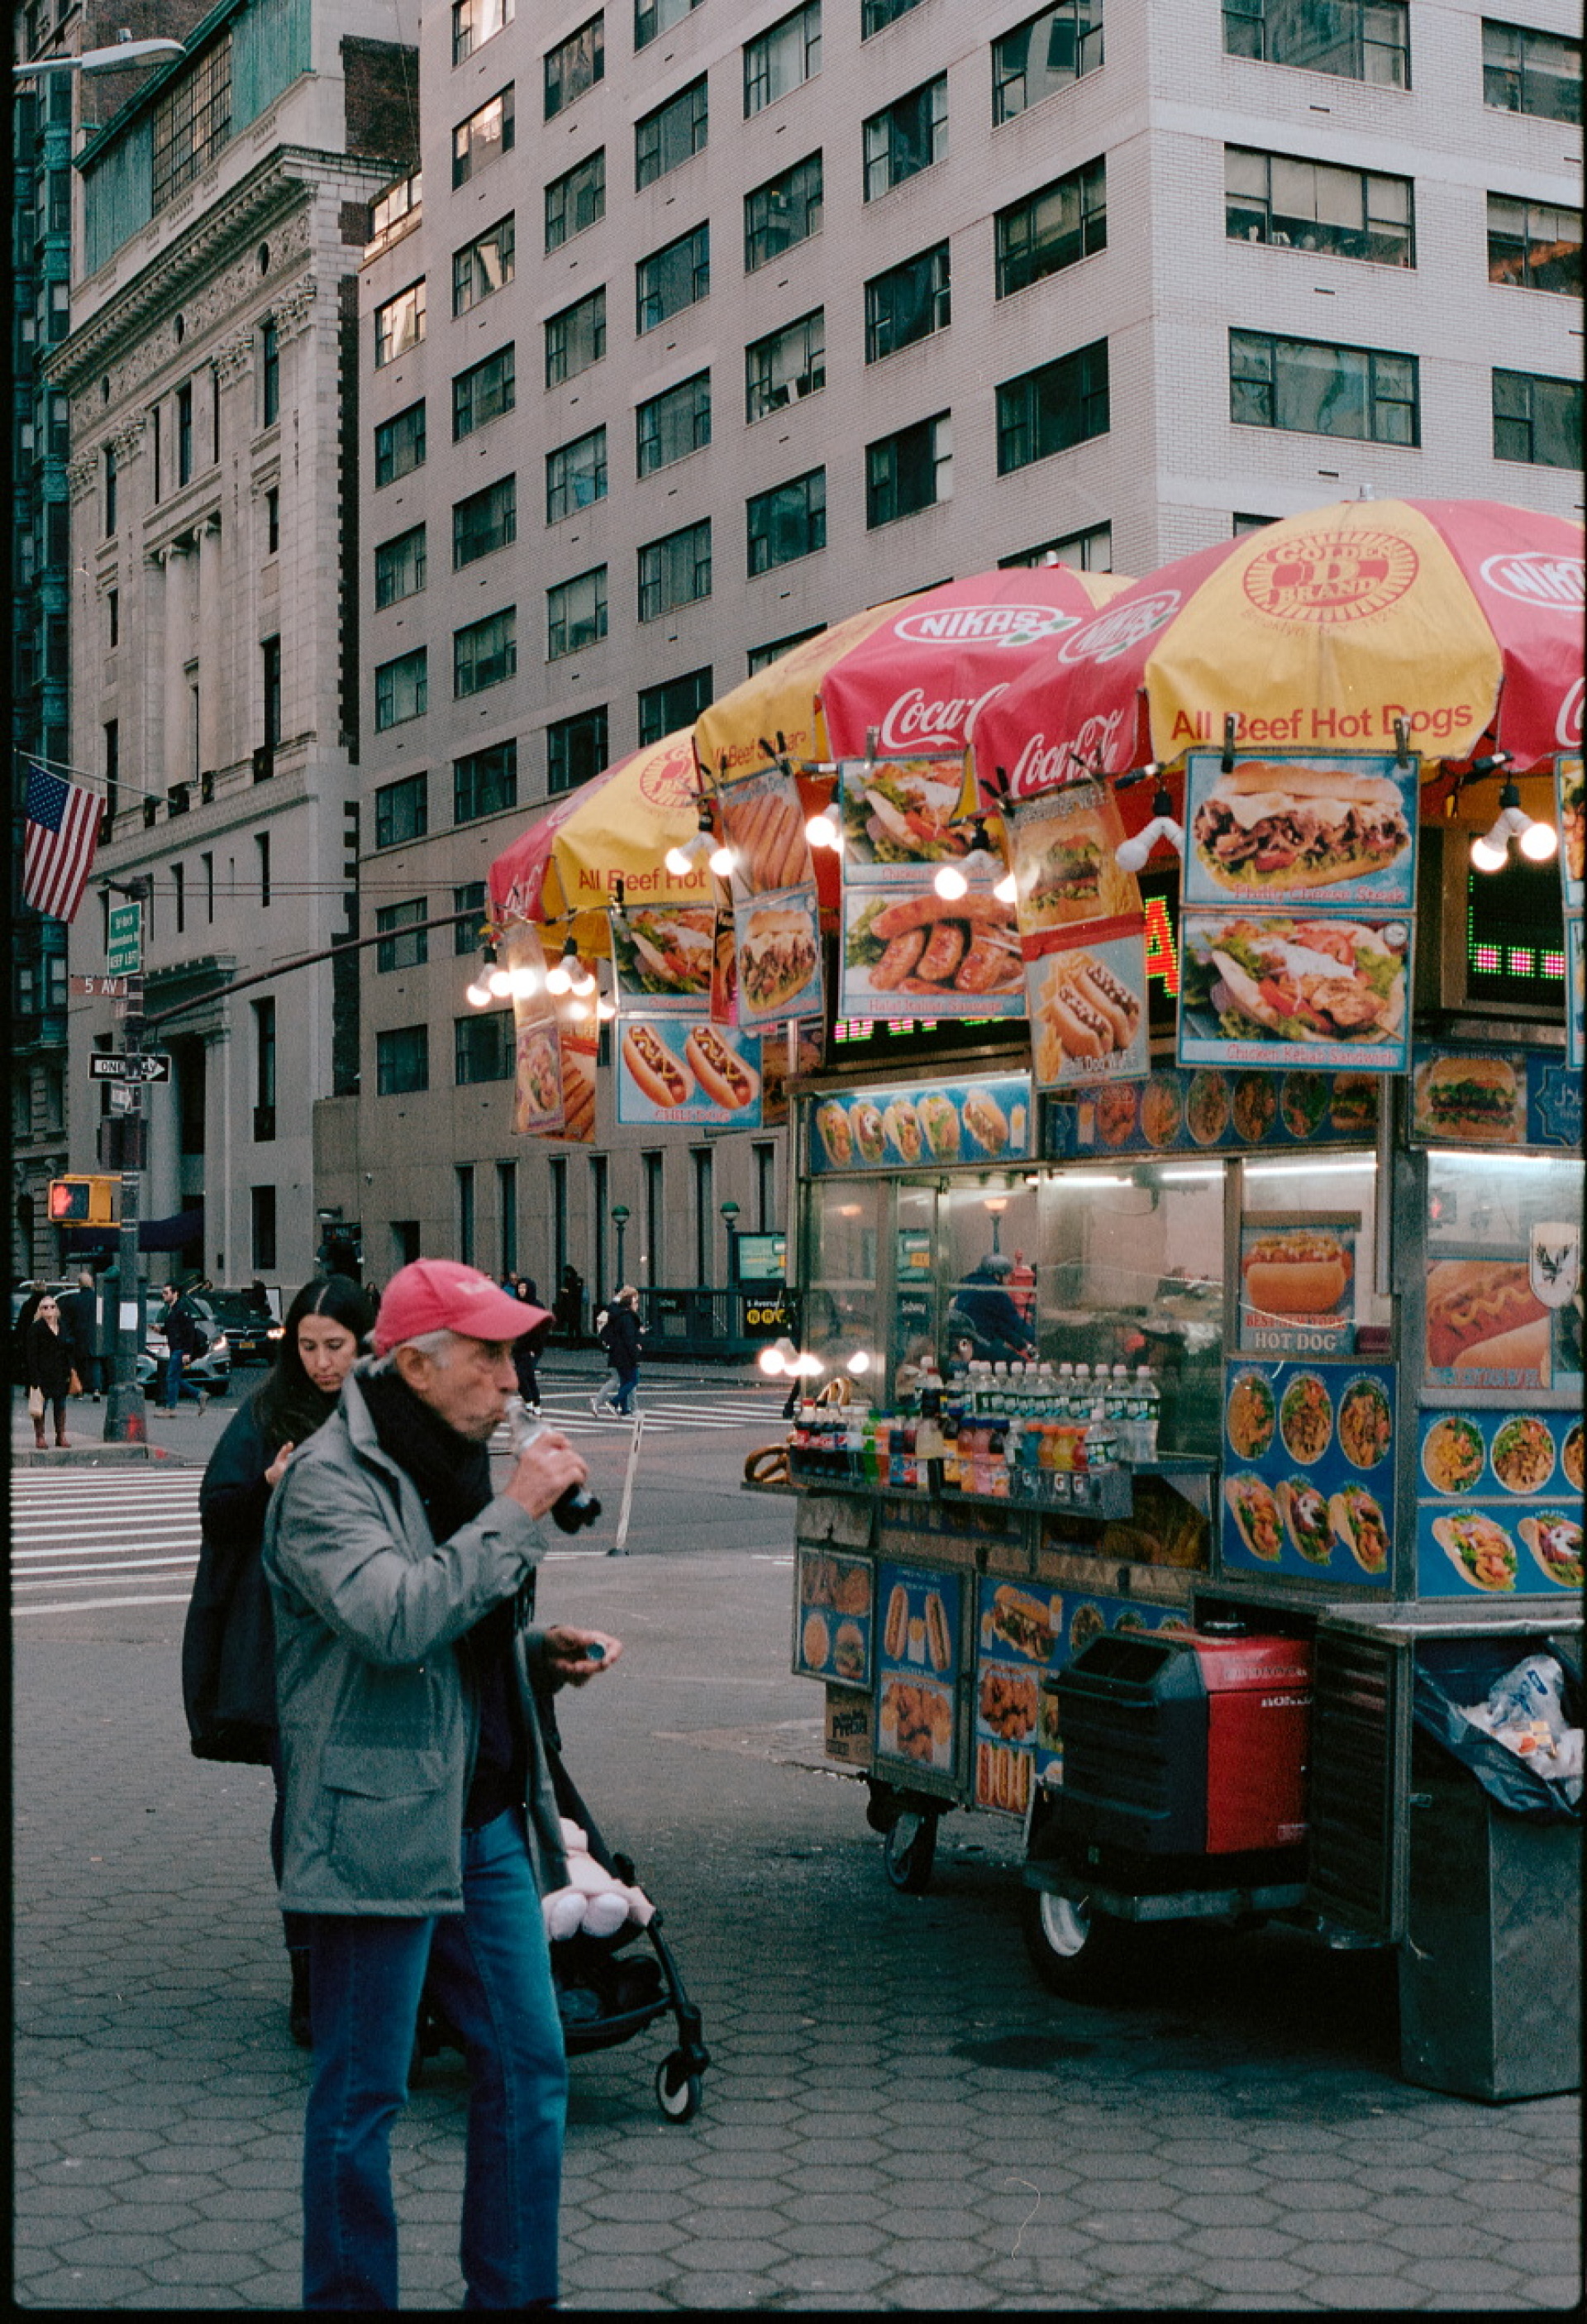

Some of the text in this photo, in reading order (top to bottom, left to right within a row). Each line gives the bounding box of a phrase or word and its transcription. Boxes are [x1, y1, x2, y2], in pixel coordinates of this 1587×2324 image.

[1275, 542, 1394, 564] GOLDEN
[1309, 561, 1360, 585] D
[1280, 580, 1377, 604] BRAND
[919, 609, 1040, 637] NIKAS
[1170, 704, 1474, 742] All Beef Hot Dogs
[579, 868, 707, 892] All Beef Hot
[1234, 883, 1284, 903] Philly
[85, 977, 117, 995] 5 AV
[1227, 1043, 1280, 1062] Chicken
[1255, 1331, 1337, 1351] HOT DOG
